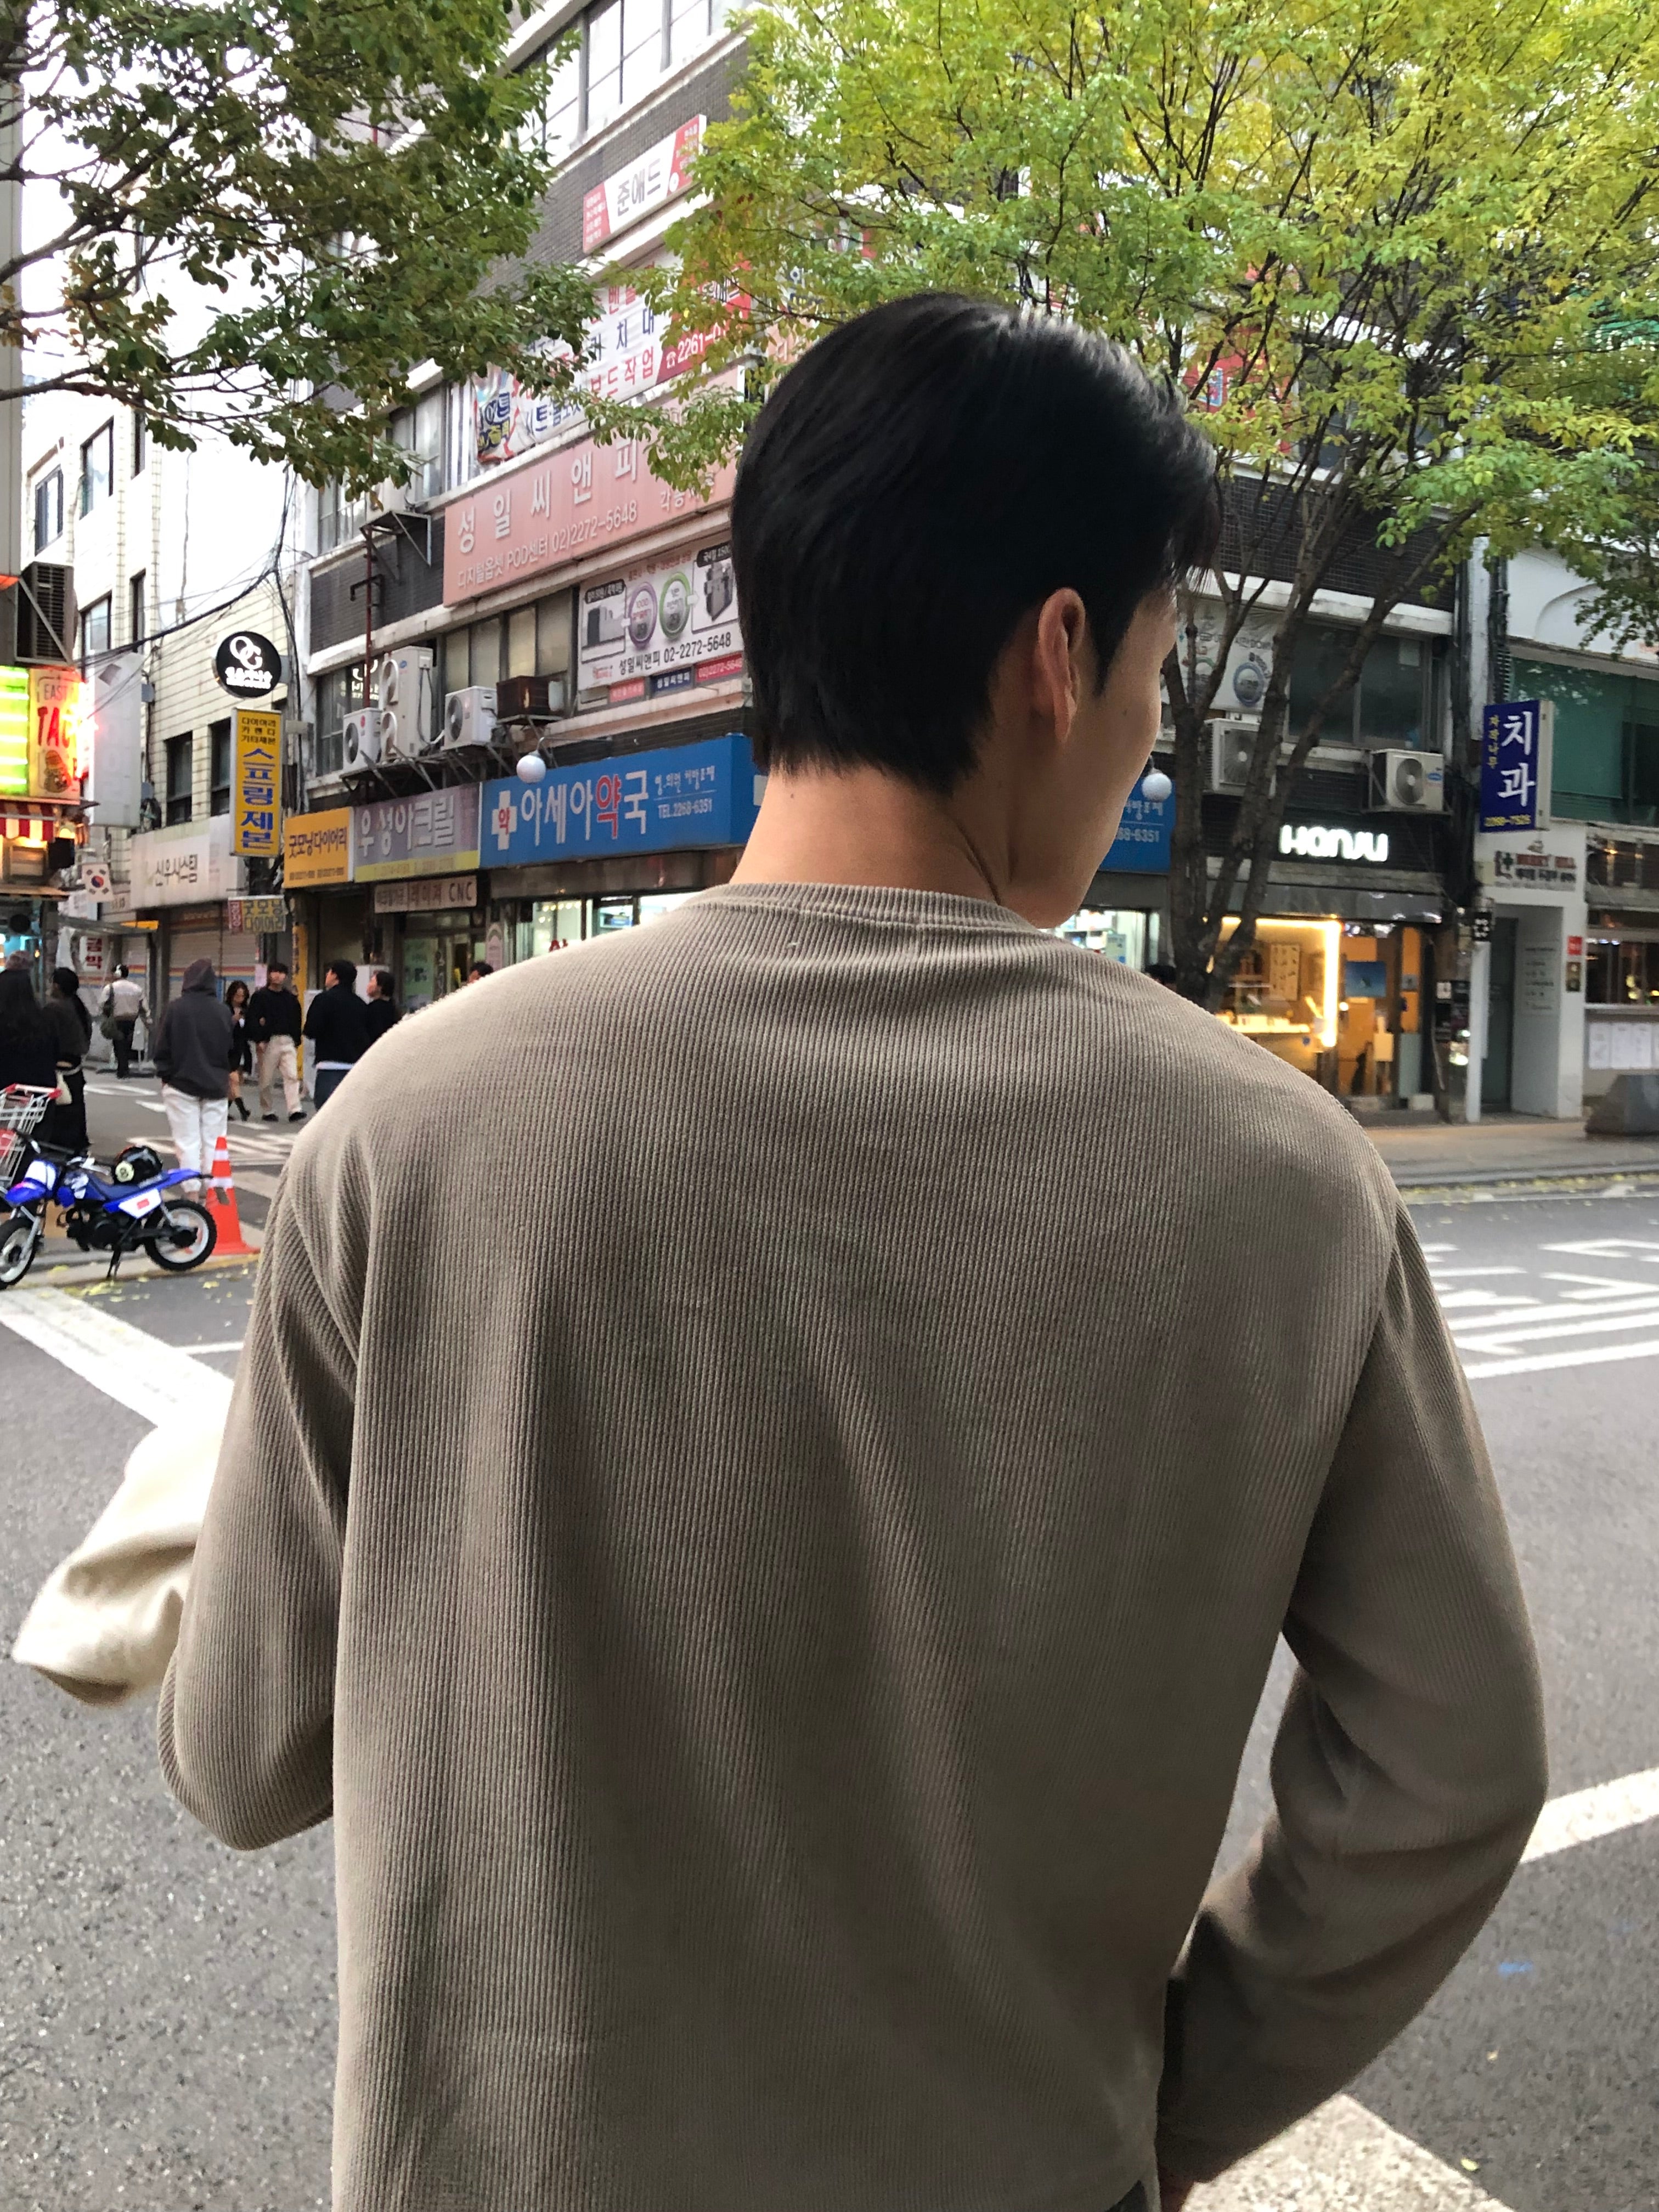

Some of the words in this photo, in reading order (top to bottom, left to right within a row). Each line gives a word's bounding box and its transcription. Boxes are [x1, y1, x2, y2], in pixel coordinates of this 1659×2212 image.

[617, 158, 661, 217] 준애드
[457, 556, 504, 588] 디지털옵셋
[507, 535, 549, 569] POD센터
[552, 500, 637, 553] 02)2272-5648
[619, 651, 661, 675] 성일씨앤피
[663, 631, 731, 663] 02-2272-5648
[1497, 710, 1536, 808] 치과
[240, 748, 275, 850] 스프링제본
[358, 794, 455, 857] 우성아크릴
[498, 806, 511, 836] 약
[520, 770, 649, 847] 아세아약국
[289, 826, 347, 859] 굿모닝다이어리
[243, 899, 283, 916] 굿모닝
[449, 881, 473, 902] CNC
